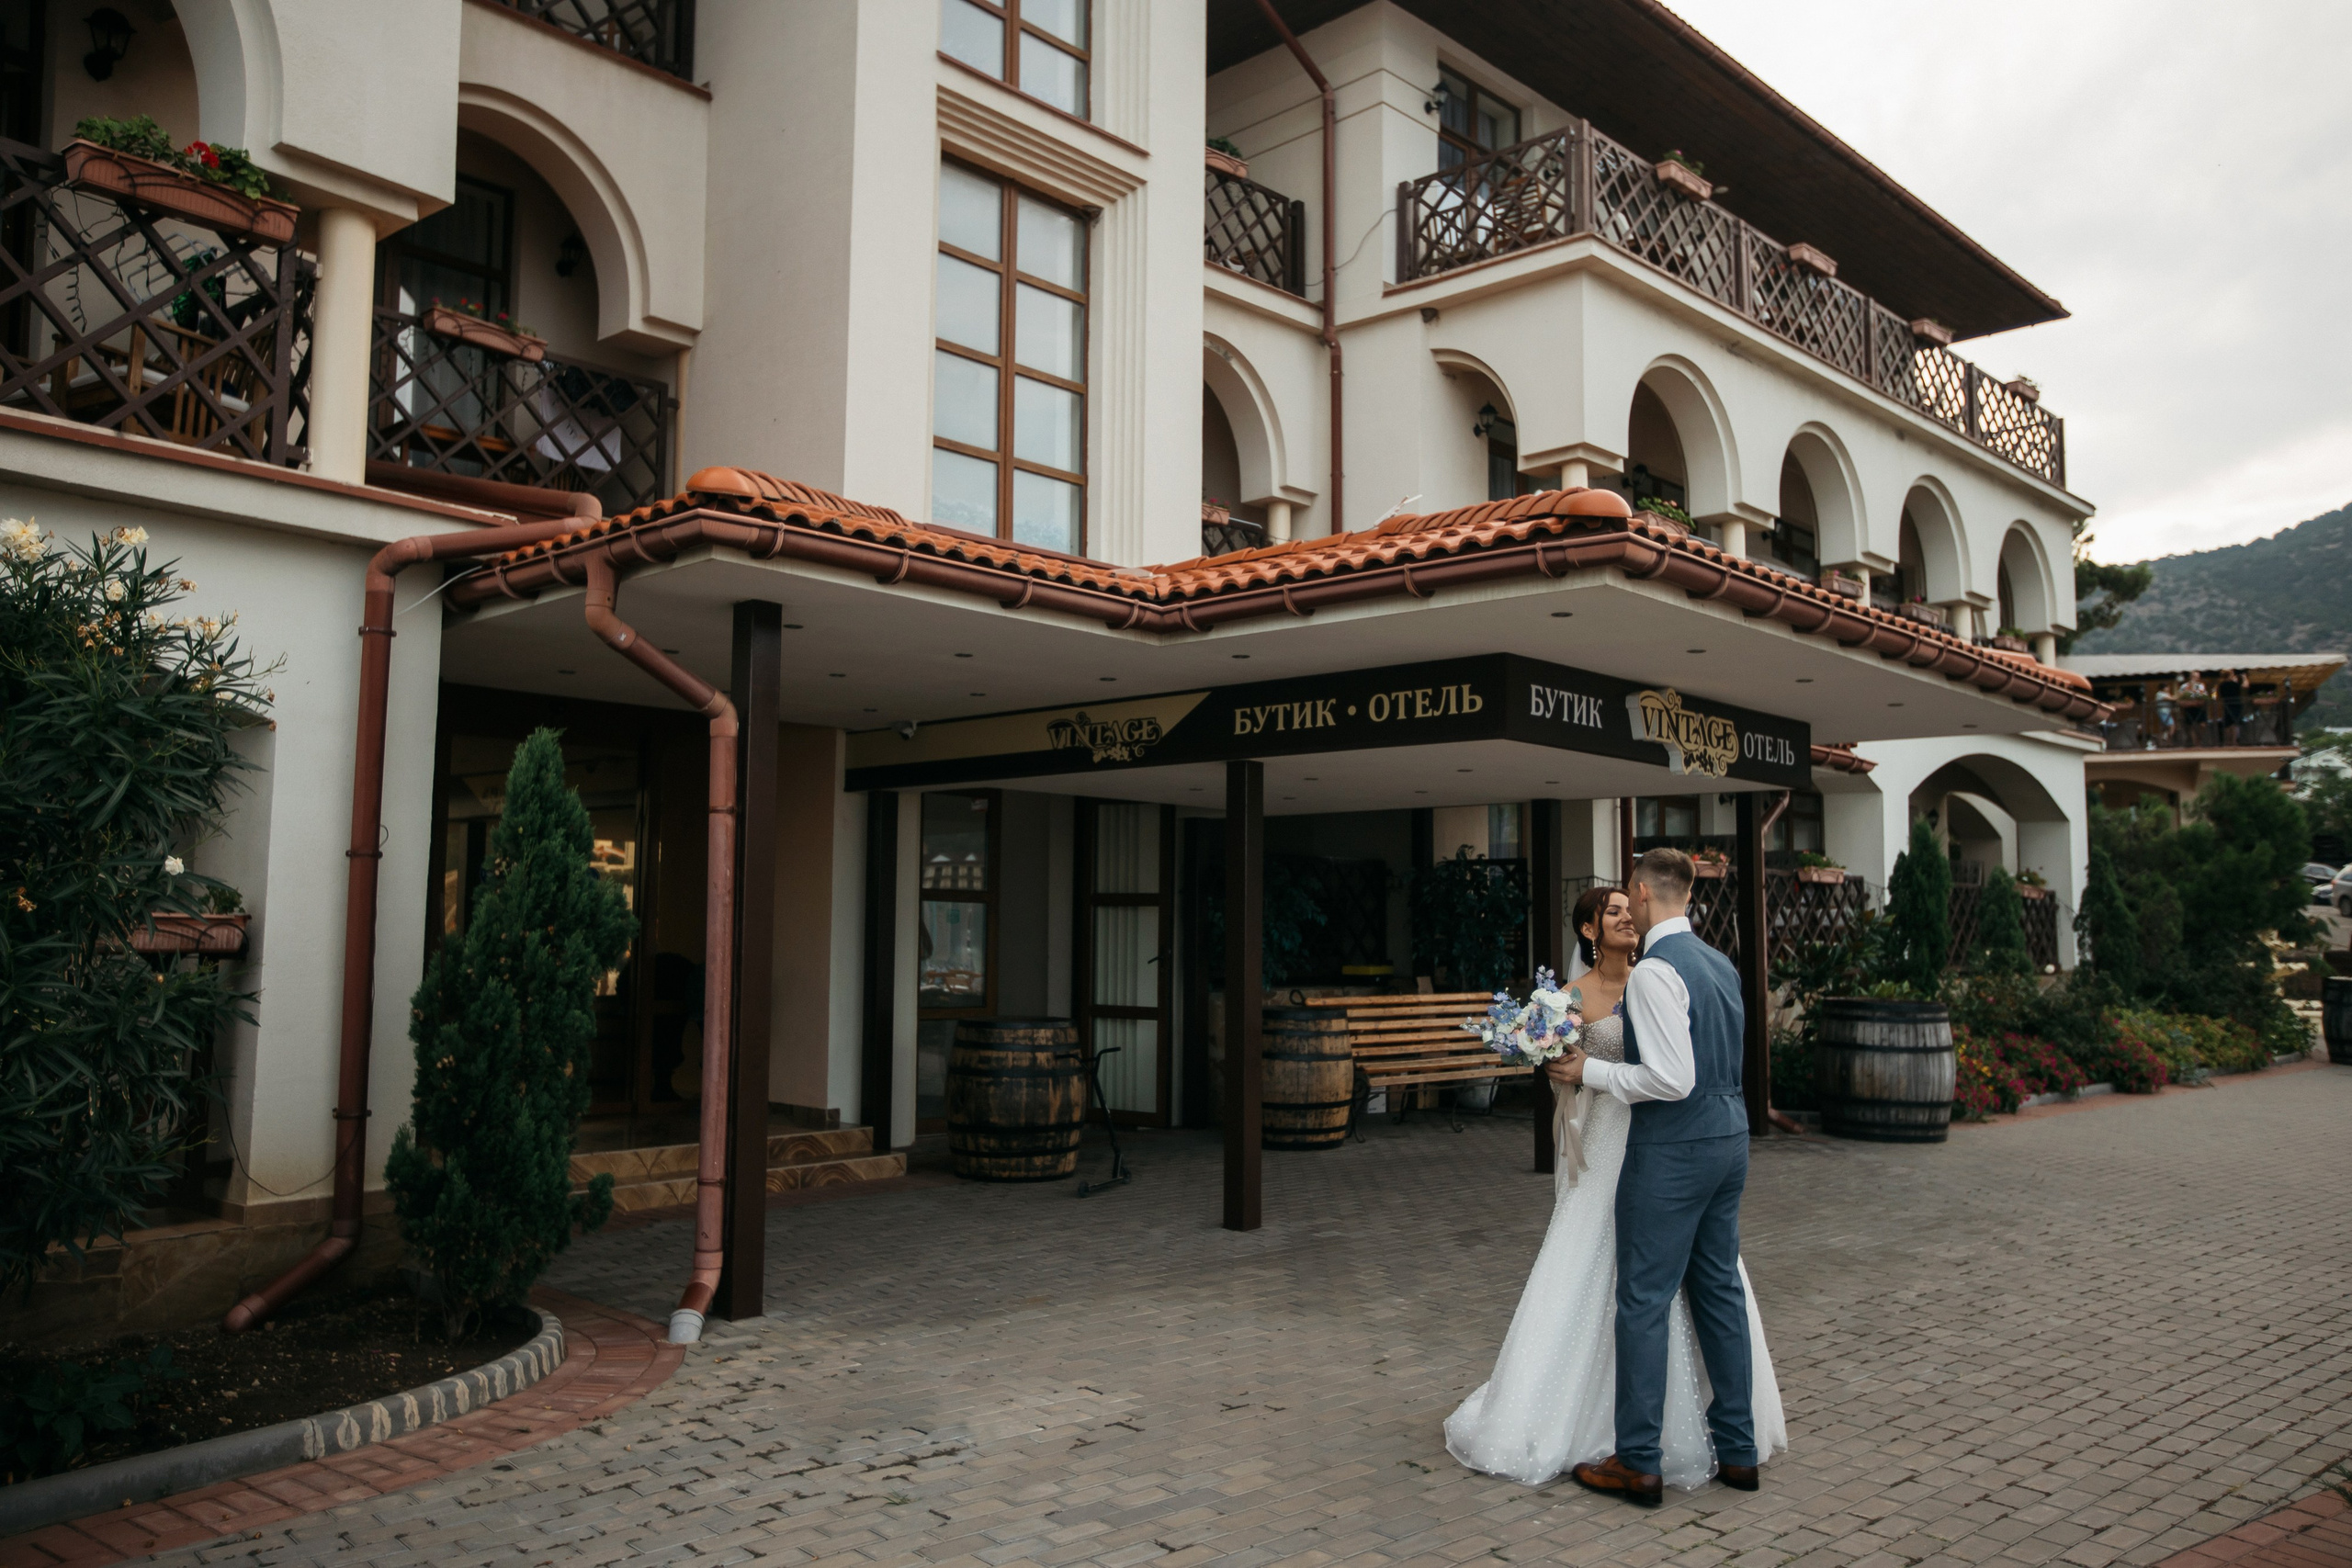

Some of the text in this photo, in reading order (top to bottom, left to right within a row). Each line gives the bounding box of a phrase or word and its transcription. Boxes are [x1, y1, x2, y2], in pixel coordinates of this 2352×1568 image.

[1046, 712, 1163, 755] VINTAGE
[1233, 683, 1484, 736] БУТИК ОТЕЛЬ
[1529, 683, 1795, 766] БУТИК VINTAGE ОТЕЛЬ
